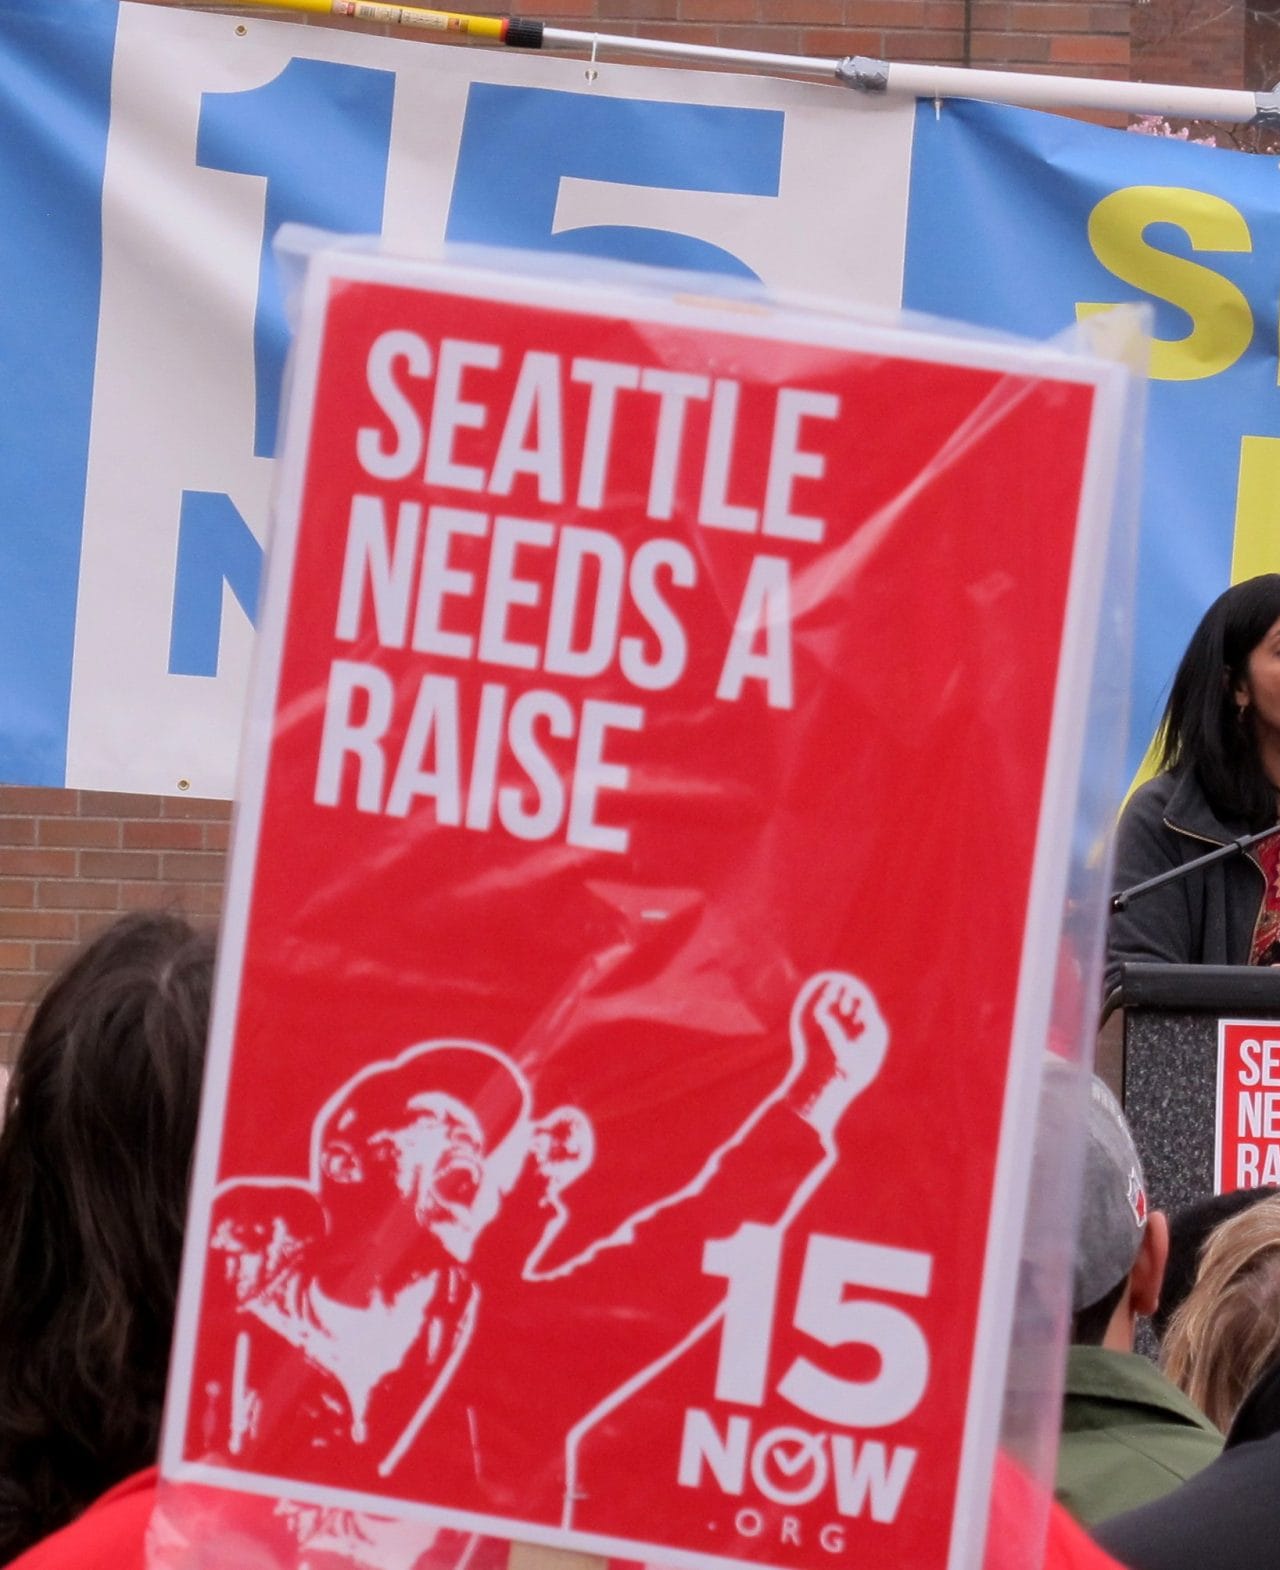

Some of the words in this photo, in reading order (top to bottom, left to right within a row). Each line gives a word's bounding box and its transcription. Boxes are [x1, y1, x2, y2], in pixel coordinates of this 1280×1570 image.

[357, 329, 841, 544] SEATTLE
[334, 494, 697, 691] NEEDS
[715, 554, 794, 710] A
[314, 659, 645, 854] RAISE
[701, 1221, 933, 1428] 15
[677, 1407, 918, 1524] NOW
